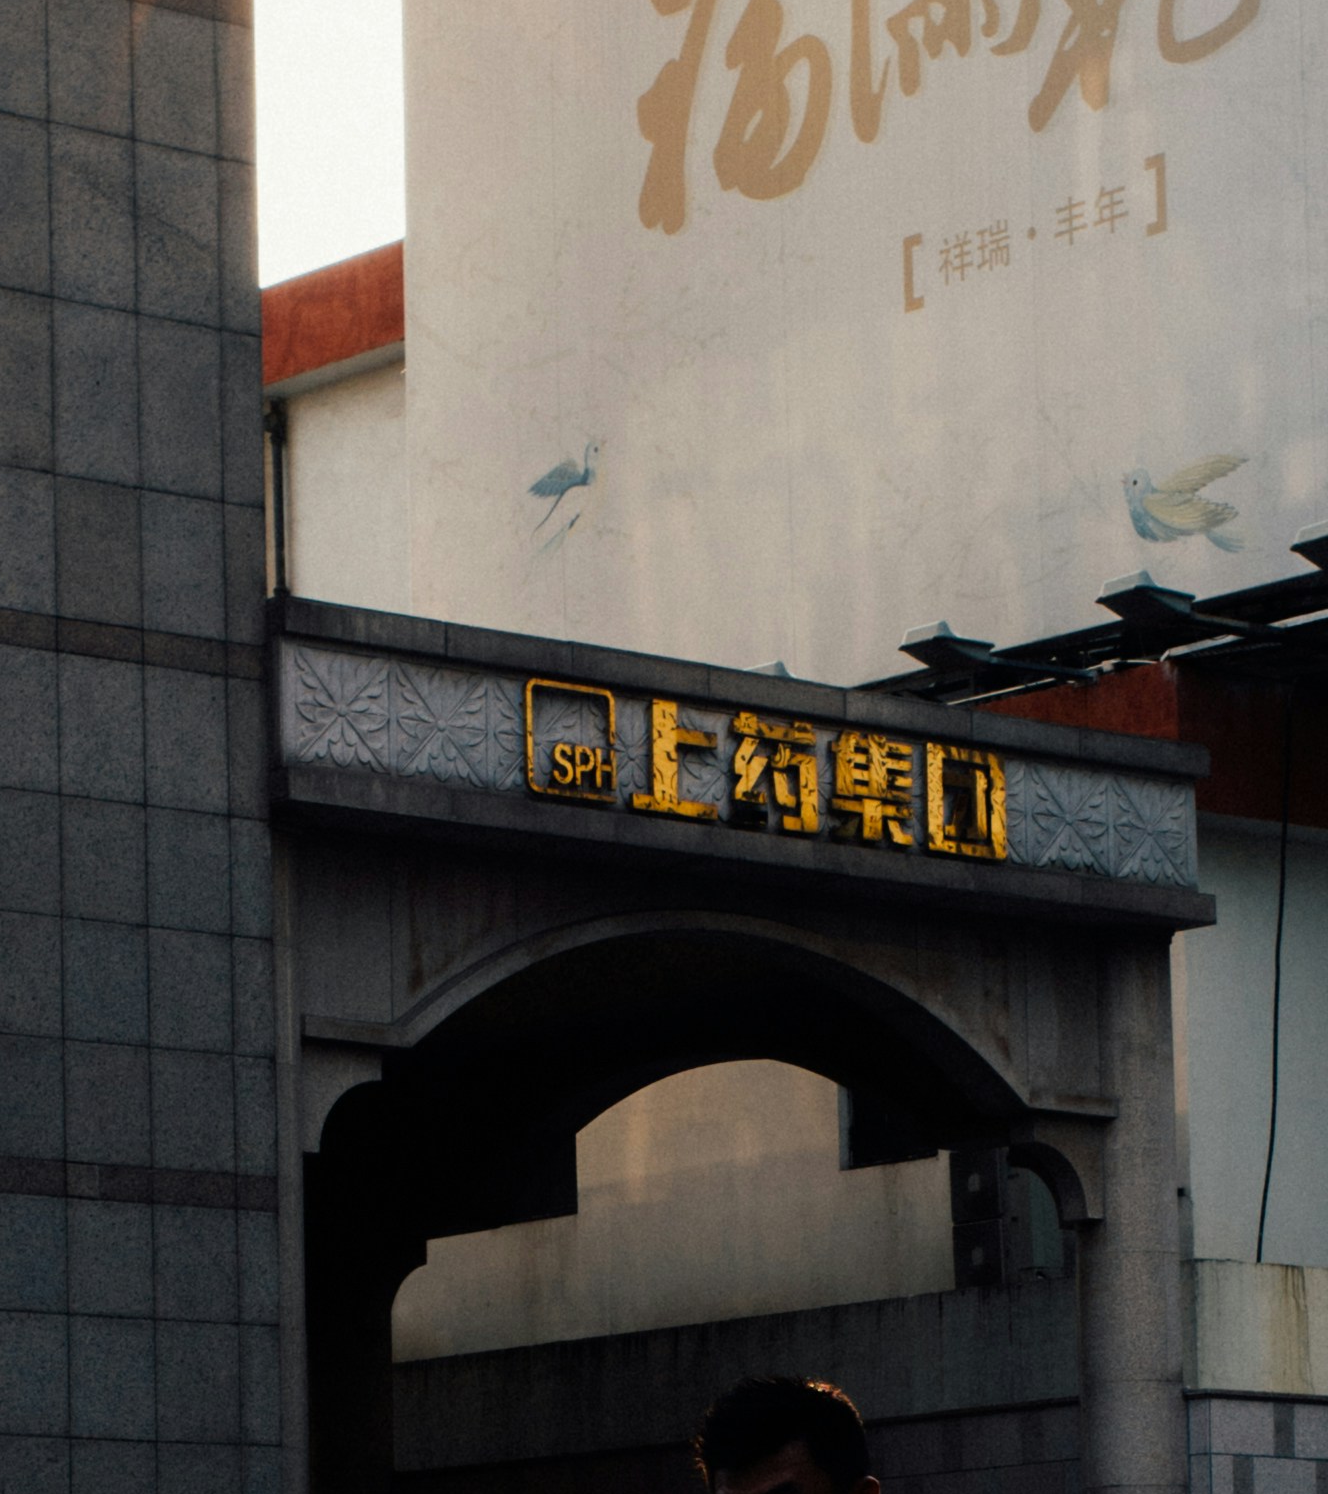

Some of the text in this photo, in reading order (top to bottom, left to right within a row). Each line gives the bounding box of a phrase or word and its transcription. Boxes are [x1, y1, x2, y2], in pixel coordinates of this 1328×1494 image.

[553, 742, 617, 791] SPH
[632, 698, 1008, 860] 上药集团
